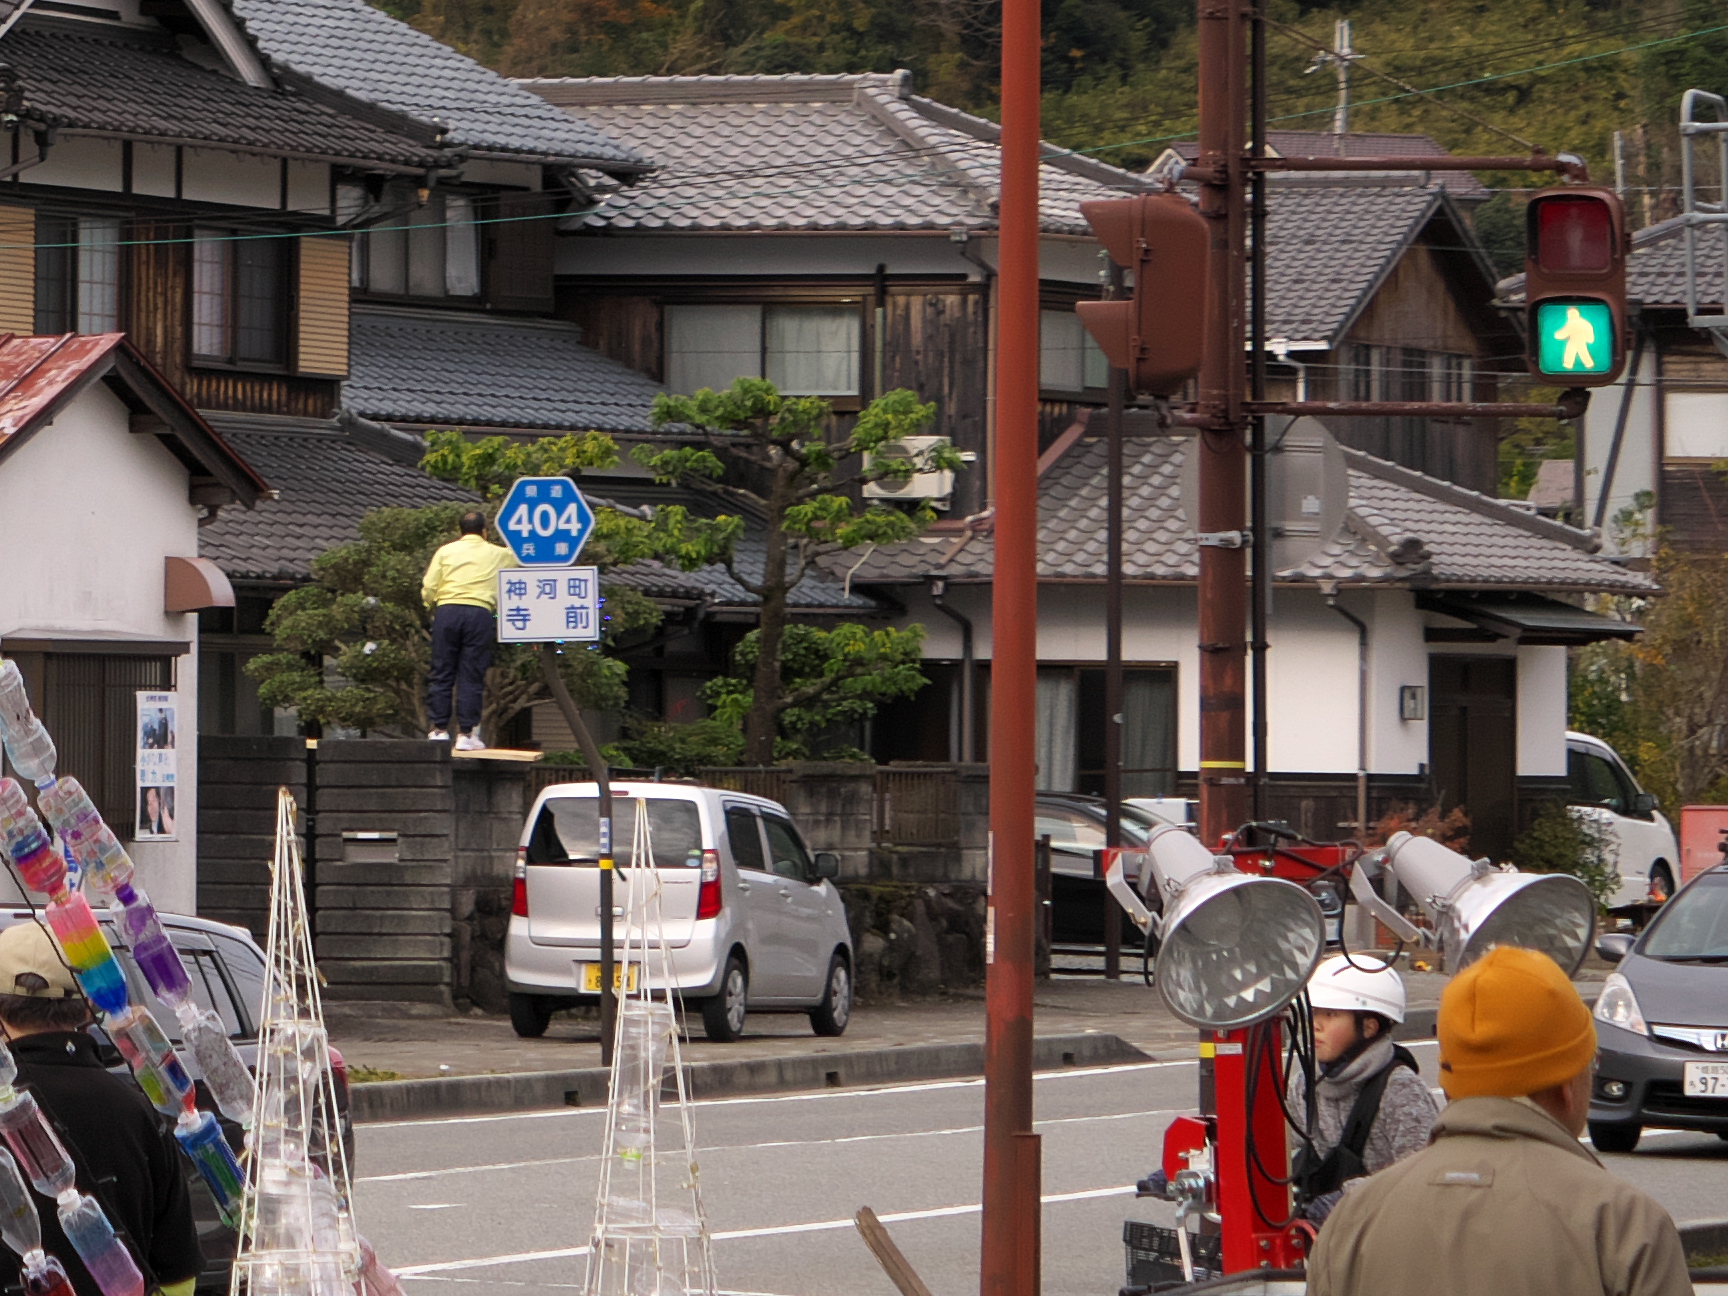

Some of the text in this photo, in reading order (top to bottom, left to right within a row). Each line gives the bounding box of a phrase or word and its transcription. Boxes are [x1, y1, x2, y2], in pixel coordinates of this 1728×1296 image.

[507, 502, 583, 538] 404
[505, 577, 589, 600] 神河町
[505, 604, 590, 631] 寺前
